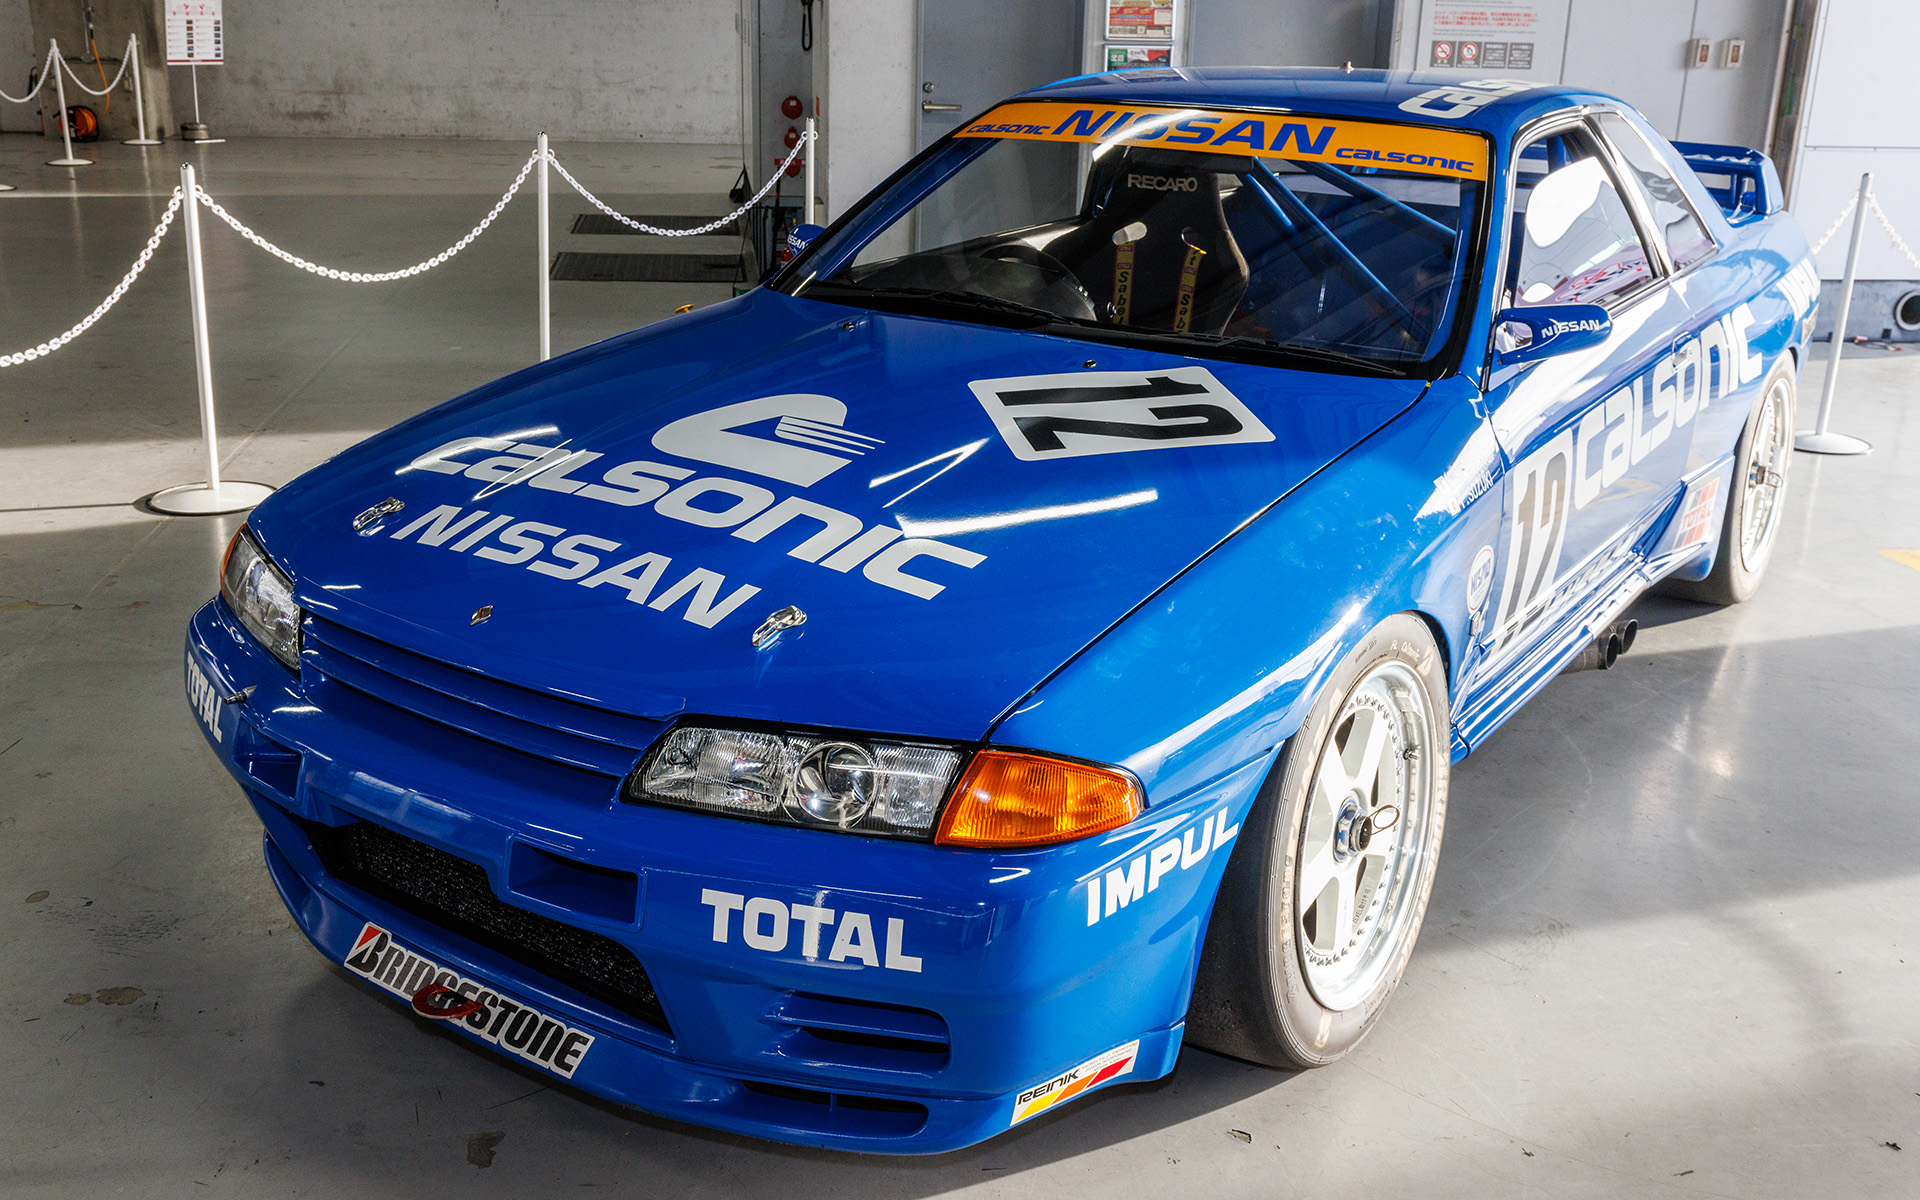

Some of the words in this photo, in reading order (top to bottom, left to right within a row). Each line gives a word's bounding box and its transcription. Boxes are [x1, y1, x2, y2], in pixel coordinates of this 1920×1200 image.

[1051, 109, 1337, 155] NISSAN
[1127, 174, 1198, 193] RECARO
[1541, 319, 1601, 339] NISSAN
[994, 374, 1244, 452] 12
[389, 504, 762, 630] NISSAN
[1501, 451, 1567, 649] 12
[187, 651, 222, 744] TOTAL
[1087, 806, 1240, 928] IMPUL
[701, 888, 923, 974] TOTAL
[1017, 1068, 1080, 1106] REINIK
